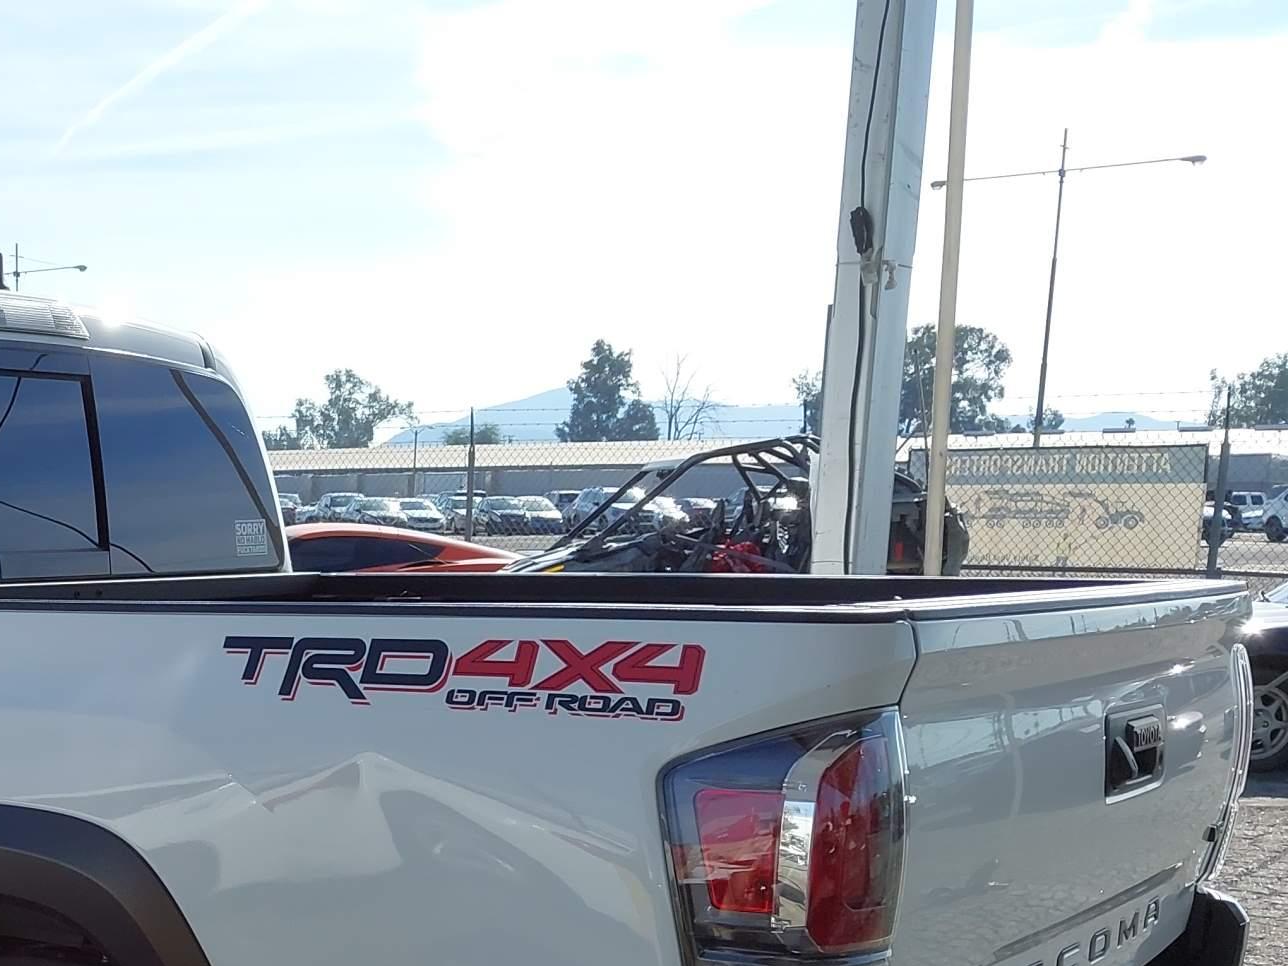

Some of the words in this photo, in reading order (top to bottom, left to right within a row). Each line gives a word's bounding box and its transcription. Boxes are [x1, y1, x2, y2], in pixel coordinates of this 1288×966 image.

[234, 522, 264, 535] SORRY
[223, 636, 452, 706] TRD
[450, 639, 707, 696] 4X4
[445, 689, 541, 713] OFF
[544, 692, 686, 721] ROAD
[1133, 723, 1161, 747] TOYOT
